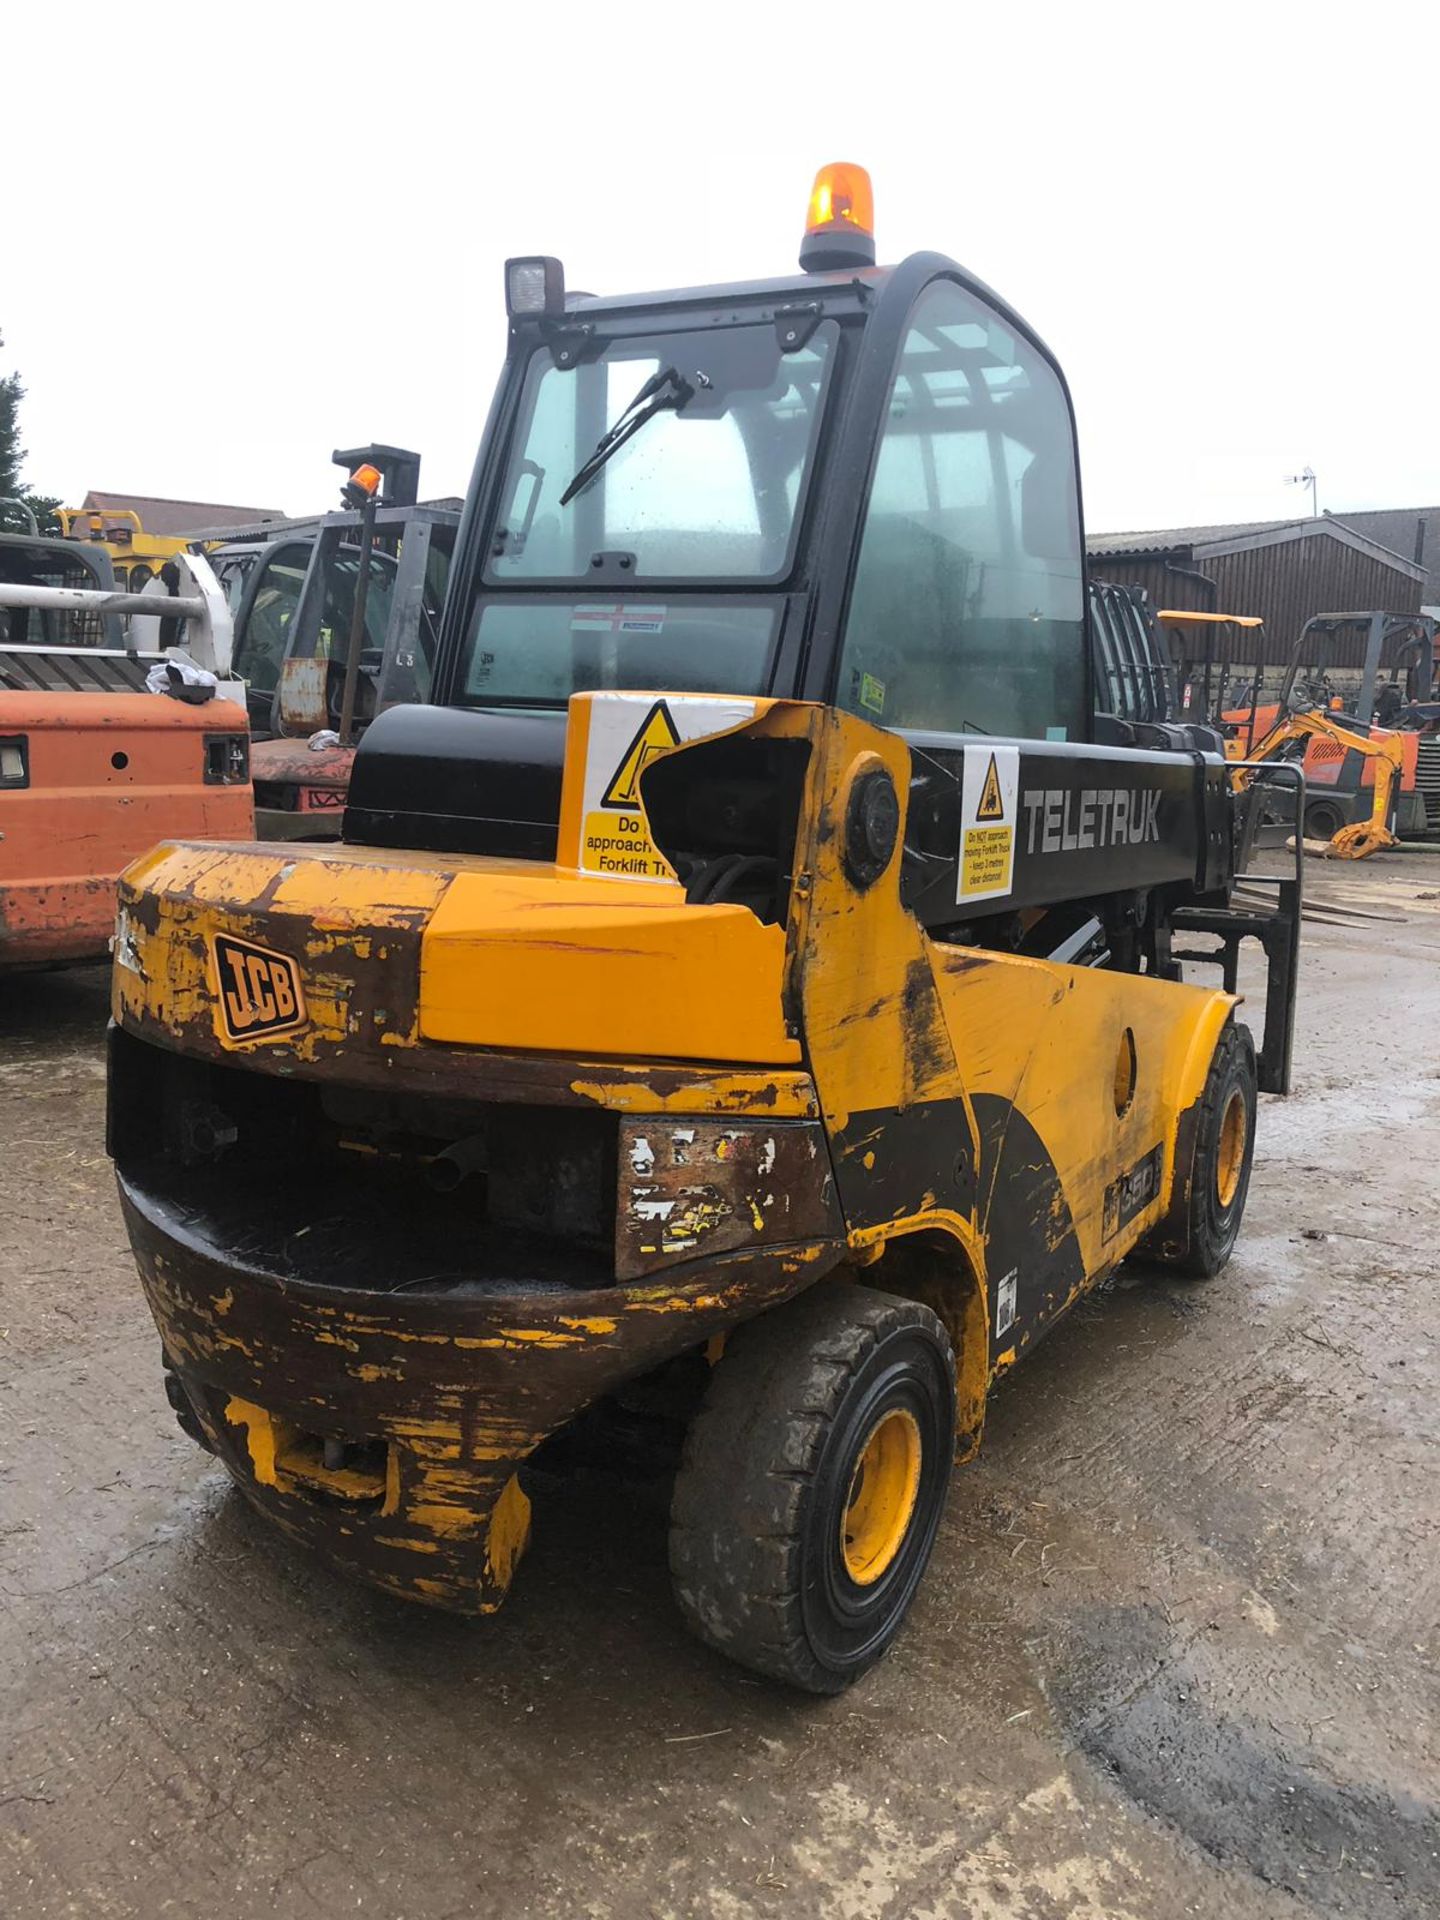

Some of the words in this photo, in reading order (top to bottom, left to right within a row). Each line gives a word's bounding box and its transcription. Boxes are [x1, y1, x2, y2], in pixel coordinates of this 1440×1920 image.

[618, 817, 639, 833] Do
[1023, 789, 1162, 854] TELETRUK
[587, 837, 652, 853] approach
[600, 856, 648, 874] Forklift
[225, 948, 295, 1028] JCB
